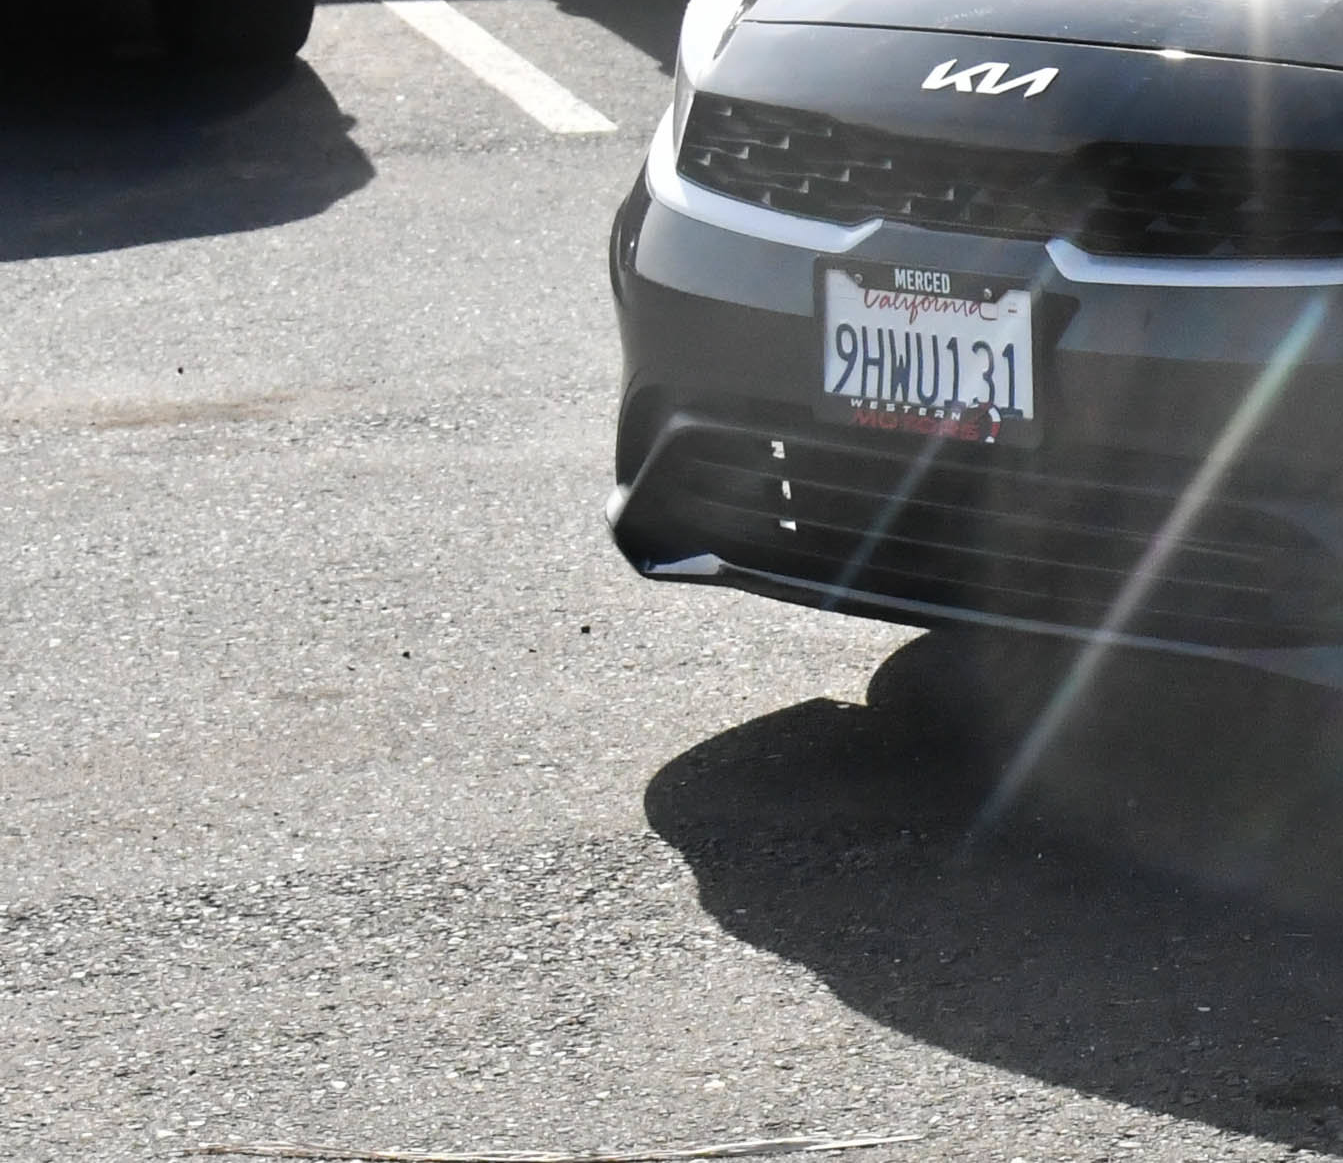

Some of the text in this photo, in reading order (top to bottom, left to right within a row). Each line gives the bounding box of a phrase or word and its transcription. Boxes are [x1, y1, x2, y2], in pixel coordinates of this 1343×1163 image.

[920, 58, 1060, 98] KIA
[894, 268, 951, 294] MERCED
[863, 288, 998, 325] California
[832, 322, 1024, 420] 9HWU131
[849, 397, 962, 421] WESTERN
